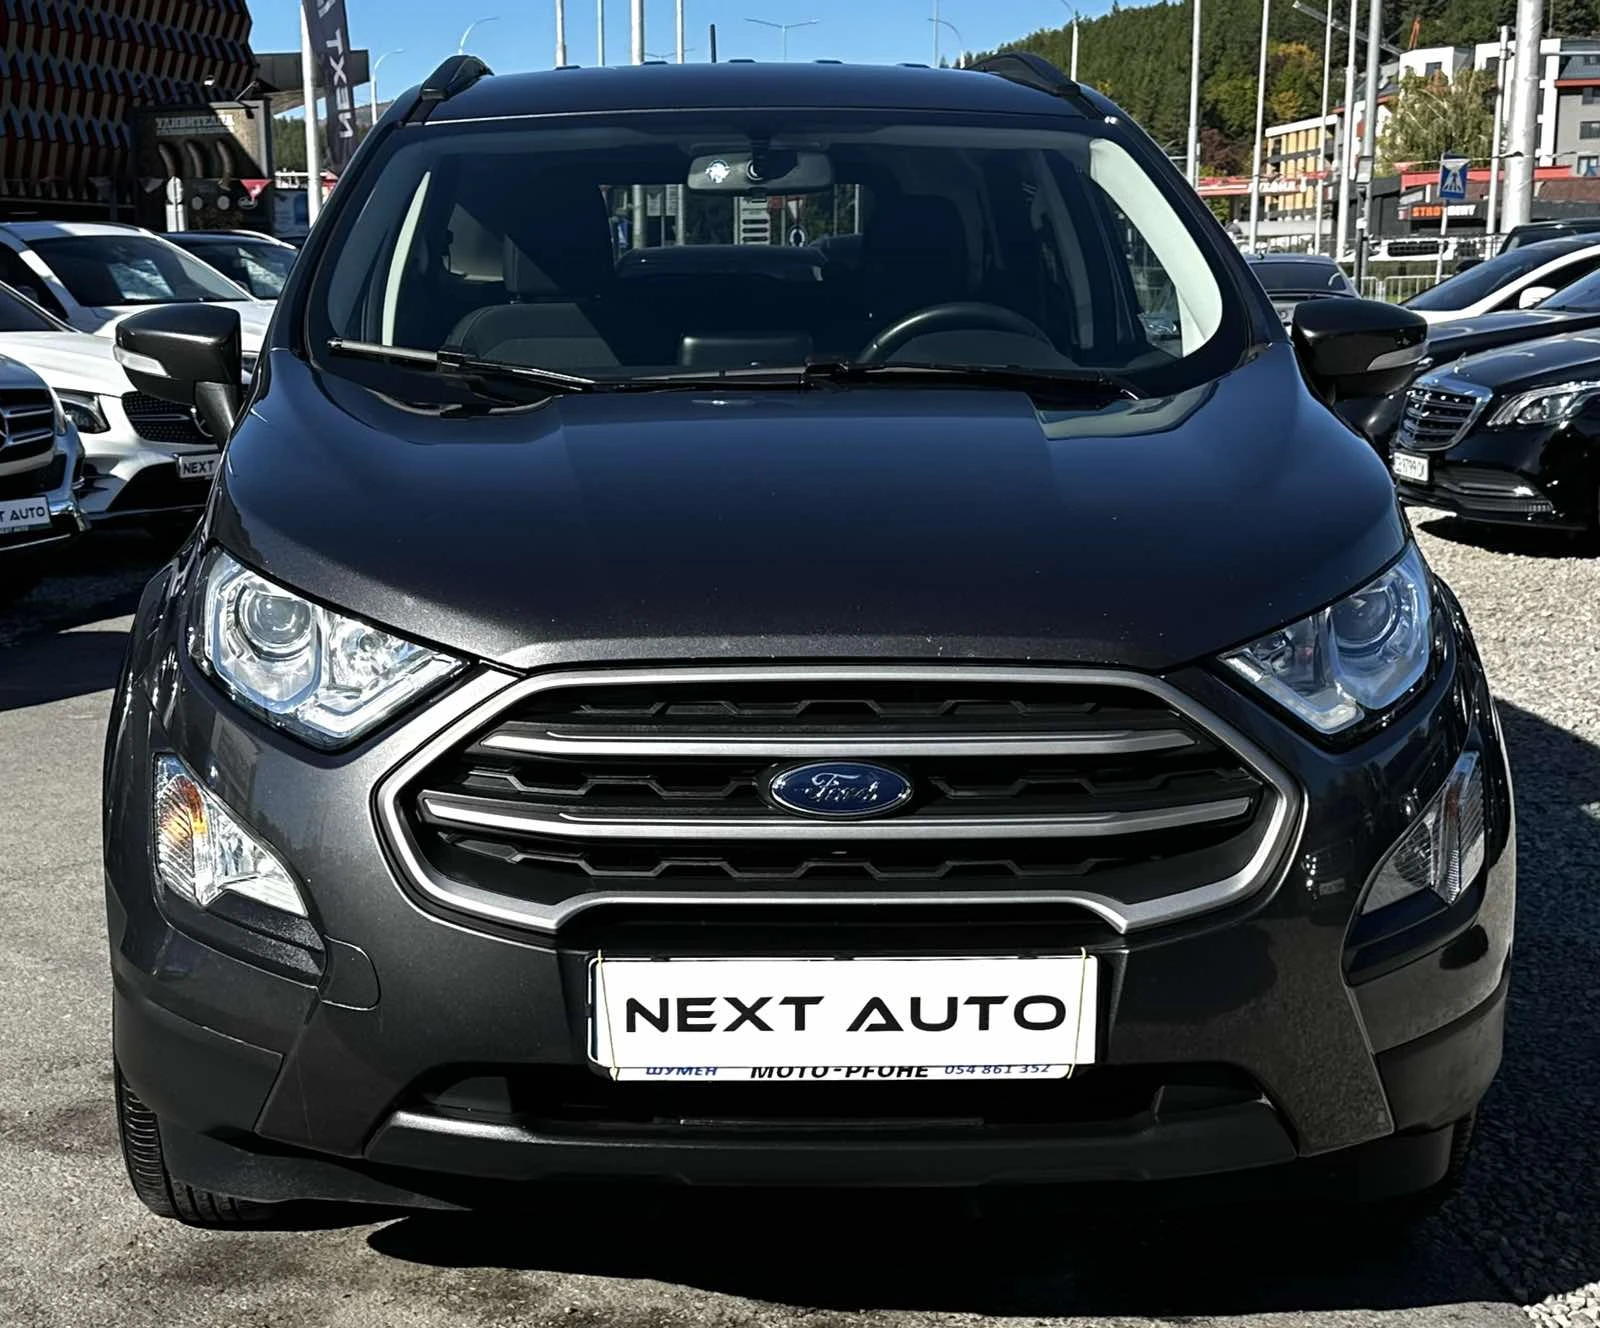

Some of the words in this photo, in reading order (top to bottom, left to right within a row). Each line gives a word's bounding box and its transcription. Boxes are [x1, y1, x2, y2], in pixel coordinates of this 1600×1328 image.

[183, 460, 215, 475] NEXT
[10, 506, 46, 521] AUTO
[804, 772, 880, 802] Ford
[626, 996, 825, 1033] NEXT
[846, 995, 1066, 1032] AUTO
